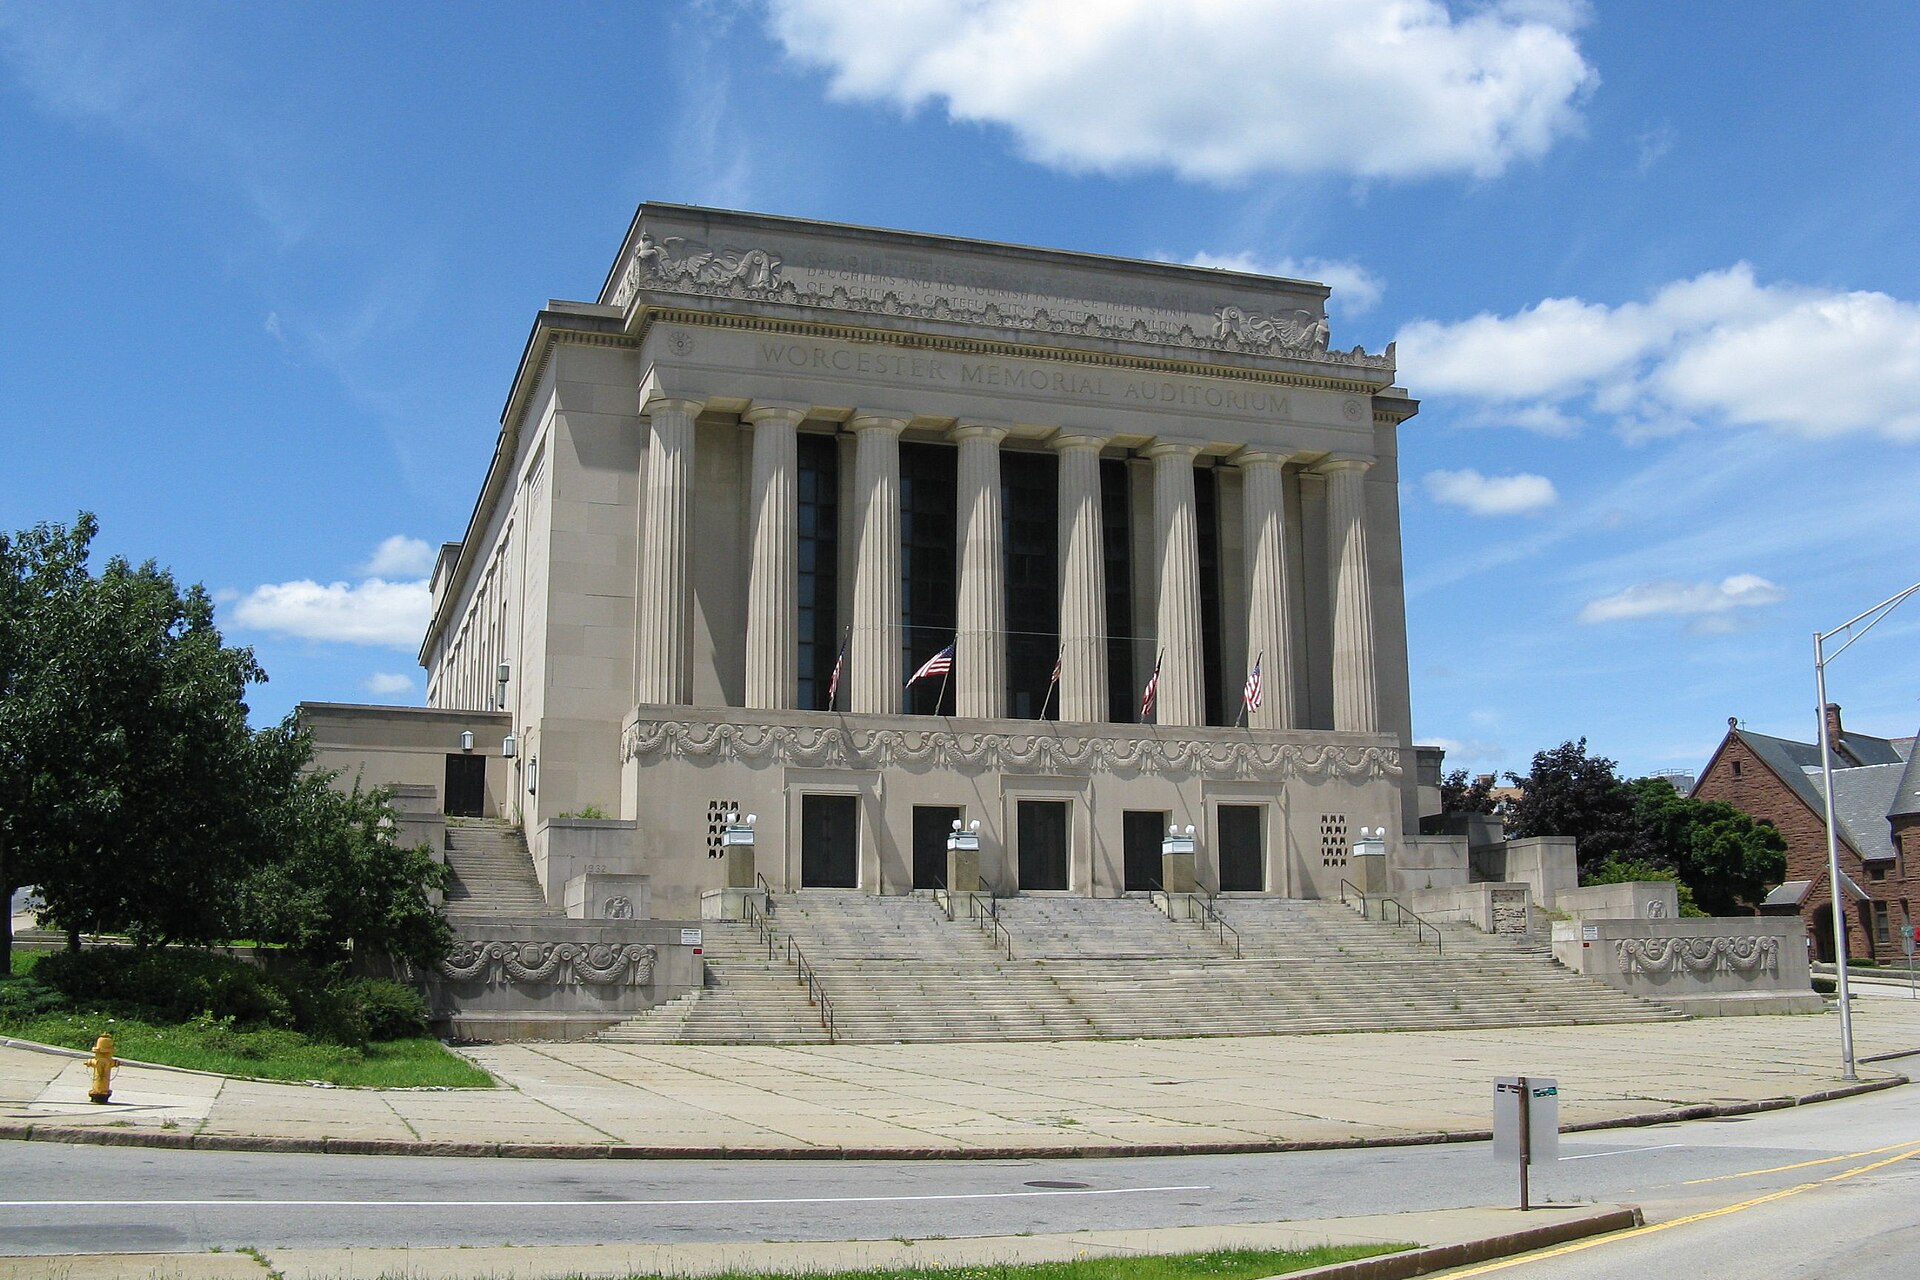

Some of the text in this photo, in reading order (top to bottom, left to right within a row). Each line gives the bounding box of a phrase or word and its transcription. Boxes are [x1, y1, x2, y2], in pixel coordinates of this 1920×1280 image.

[807, 266, 896, 285] DAUGHTERS
[938, 279, 957, 292] TO
[964, 283, 1029, 301] NOURISH
[1106, 299, 1143, 313] THEIR
[1150, 304, 1191, 319] SPIRIT
[807, 281, 826, 293] OF
[999, 302, 1028, 316] CITY
[1097, 313, 1125, 326] THIS
[763, 343, 1289, 415] WORCESTER MEMORIAL AUDITORIUM
